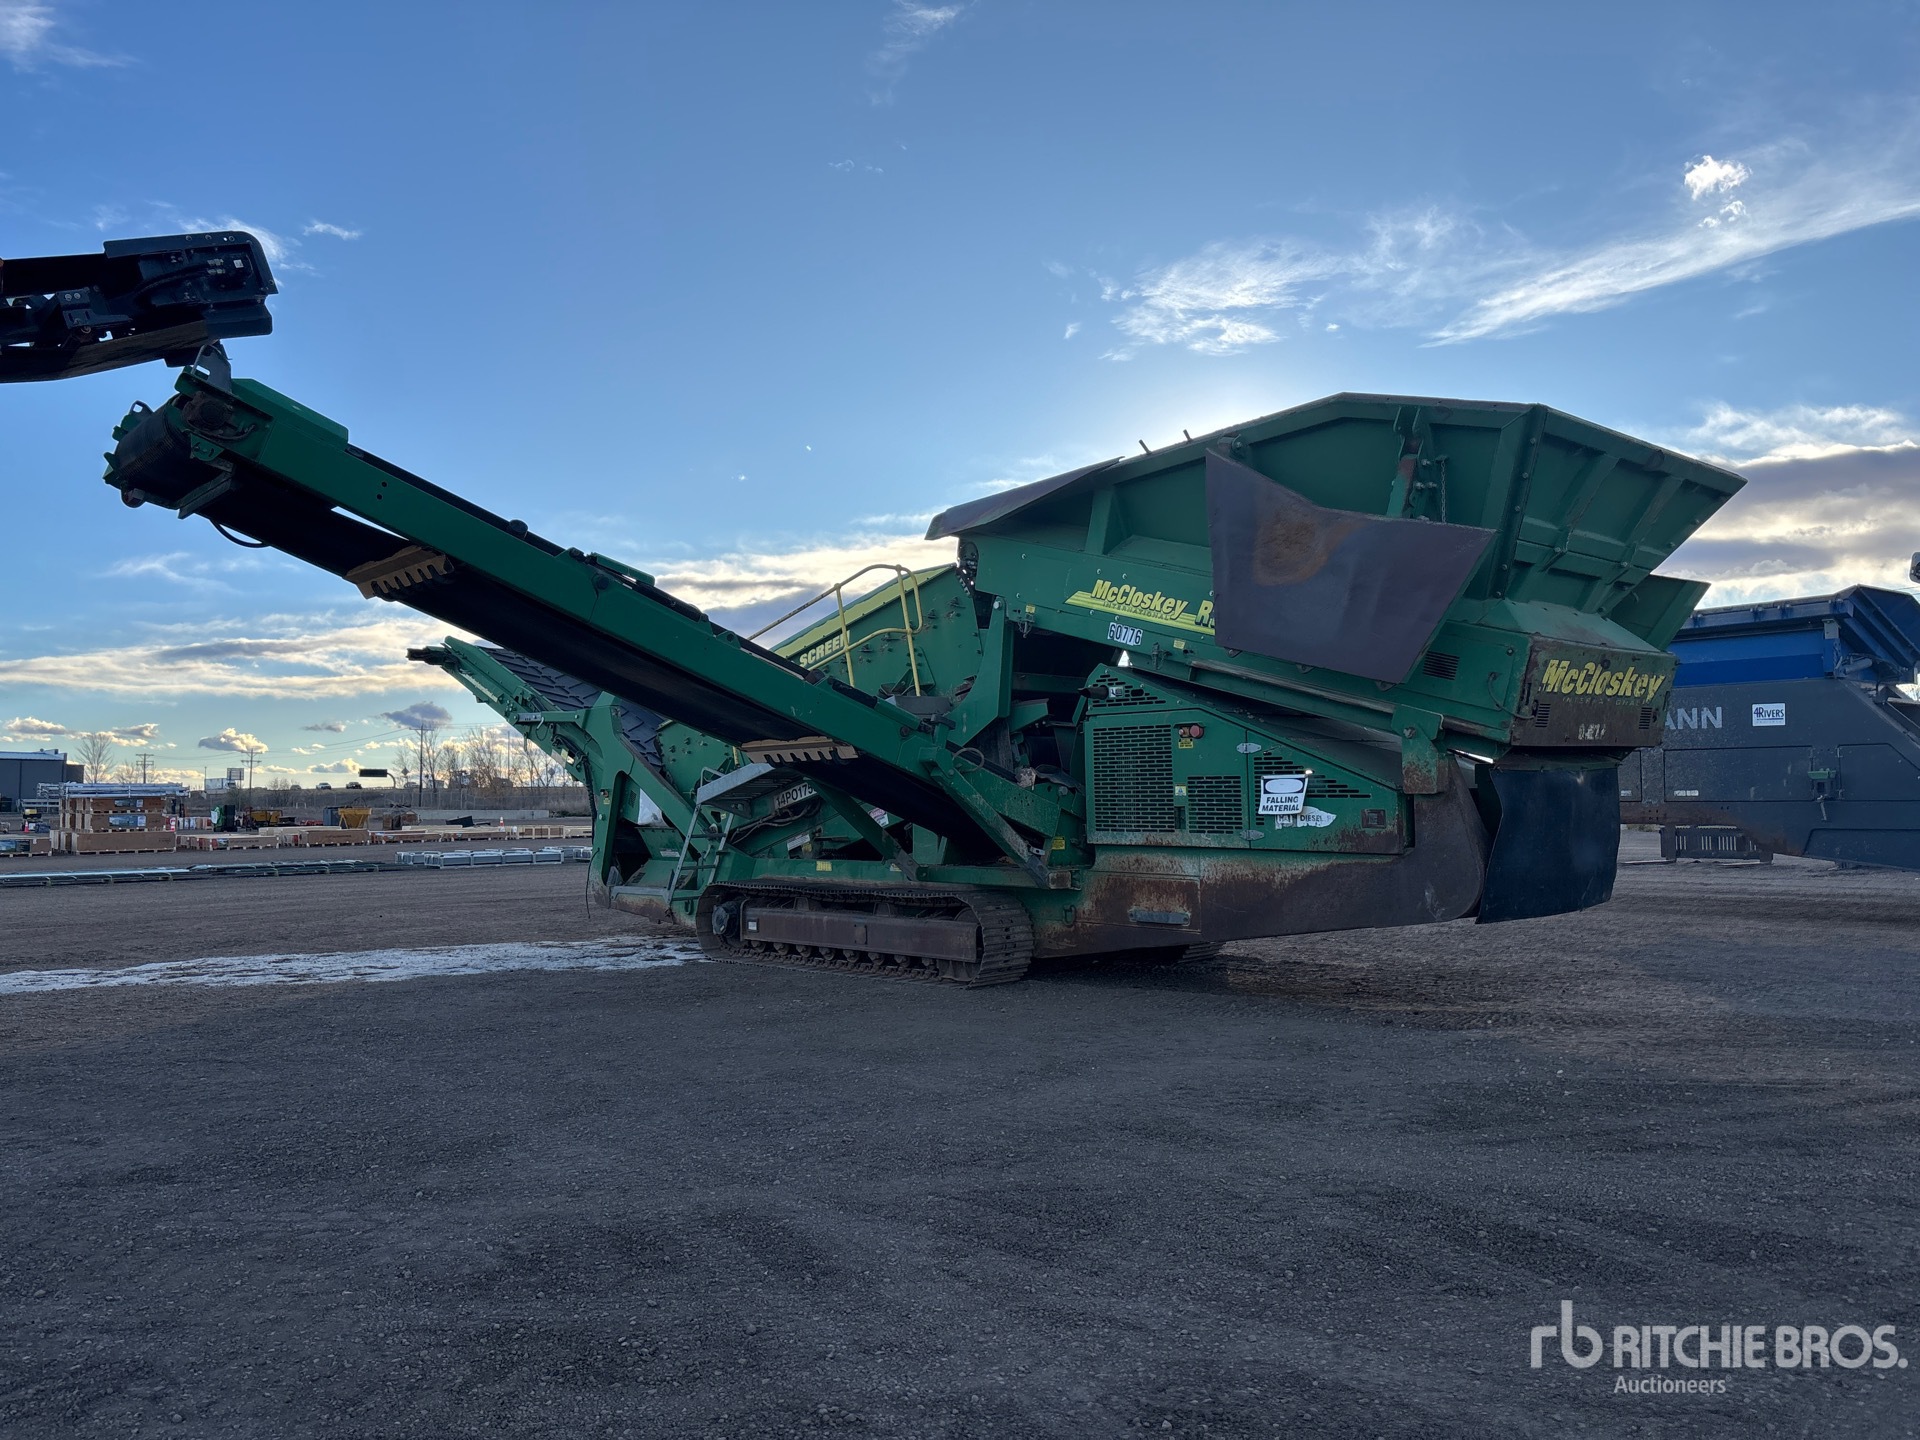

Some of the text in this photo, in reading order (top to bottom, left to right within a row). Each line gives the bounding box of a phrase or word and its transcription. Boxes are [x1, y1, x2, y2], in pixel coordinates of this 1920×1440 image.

[1091, 579, 1189, 620] McCloskey
[1108, 623, 1142, 645] 60776
[1541, 659, 1667, 703] McCloskey
[1266, 796, 1299, 804] FALLING
[1261, 804, 1300, 812] MATERIAL
[1300, 814, 1323, 822] DIESEL
